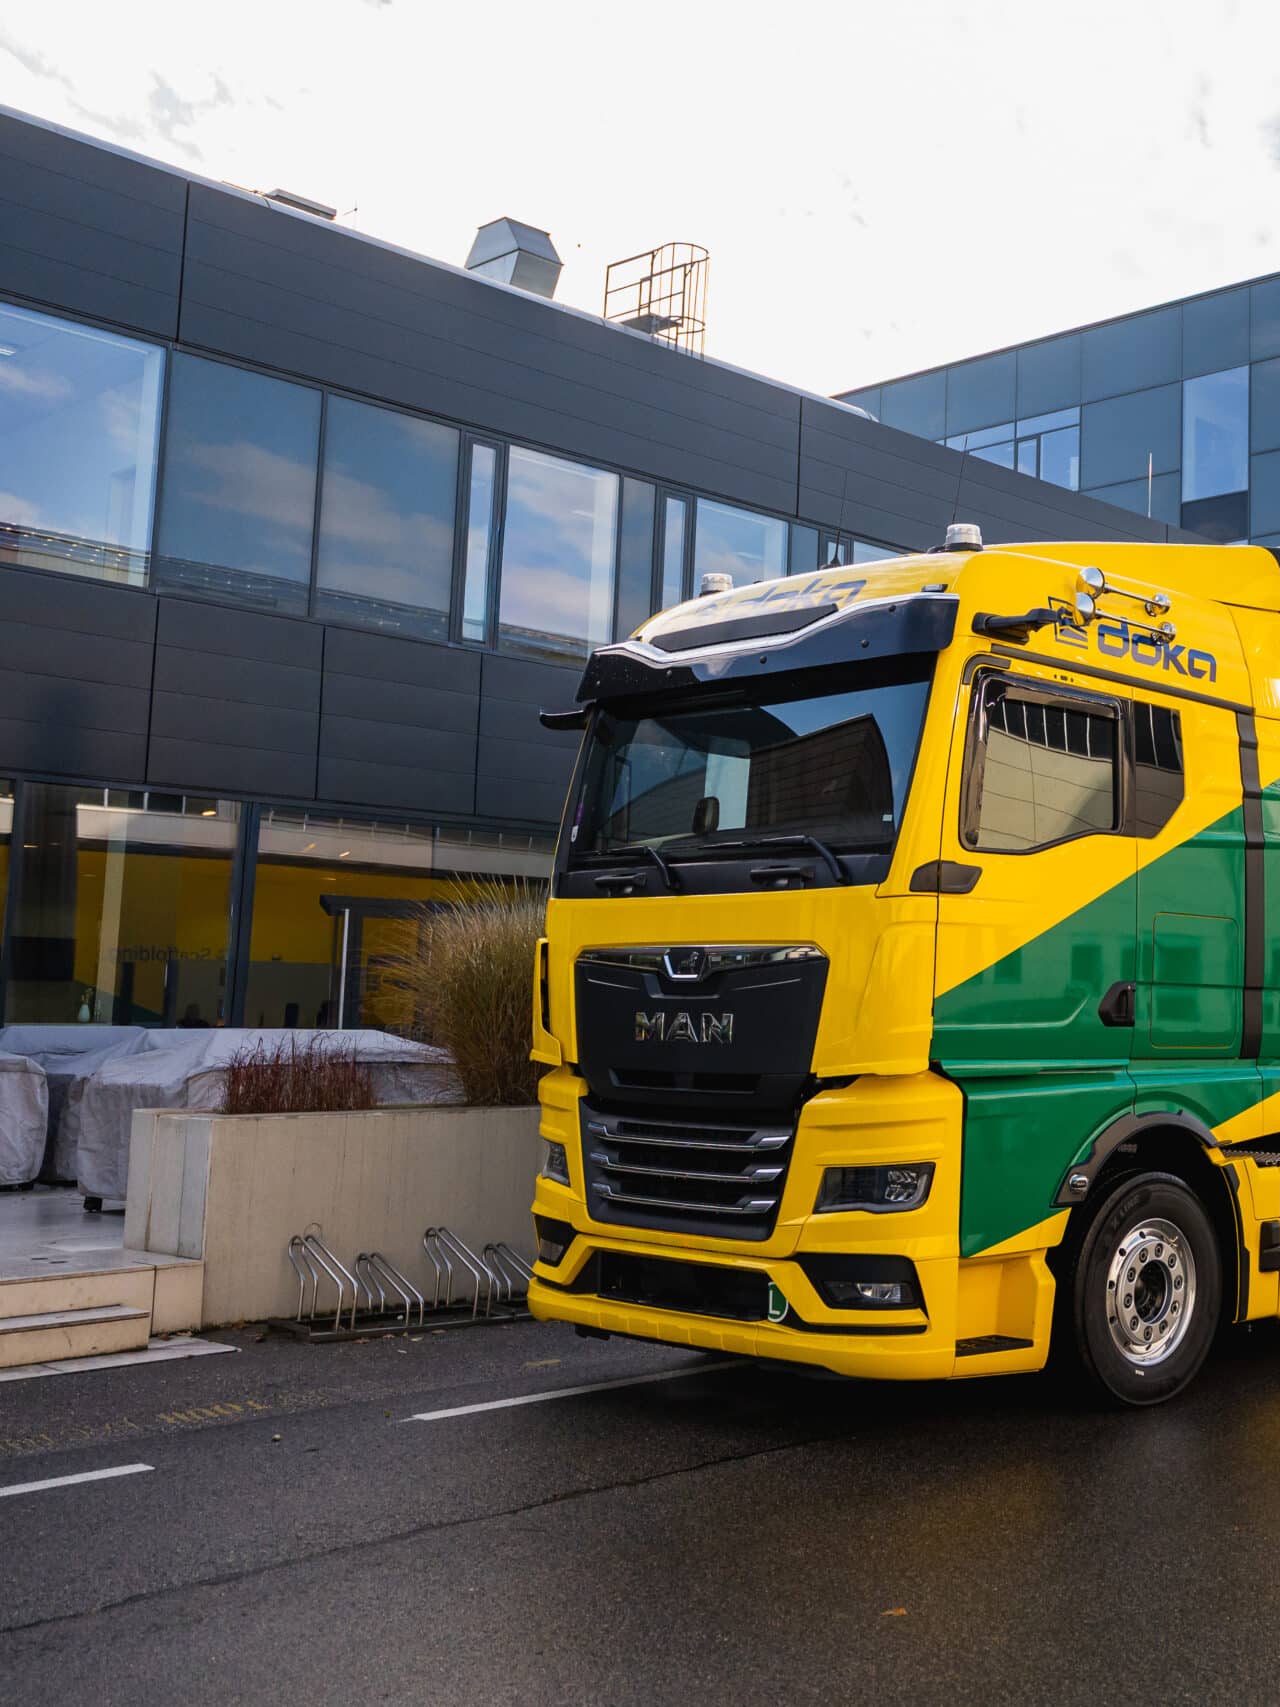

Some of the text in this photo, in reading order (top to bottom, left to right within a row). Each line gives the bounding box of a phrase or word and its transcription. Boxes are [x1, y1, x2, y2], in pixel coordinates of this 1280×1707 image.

[1097, 617, 1217, 683] doka
[635, 1012, 734, 1043] MAN
[769, 1290, 781, 1315] L
